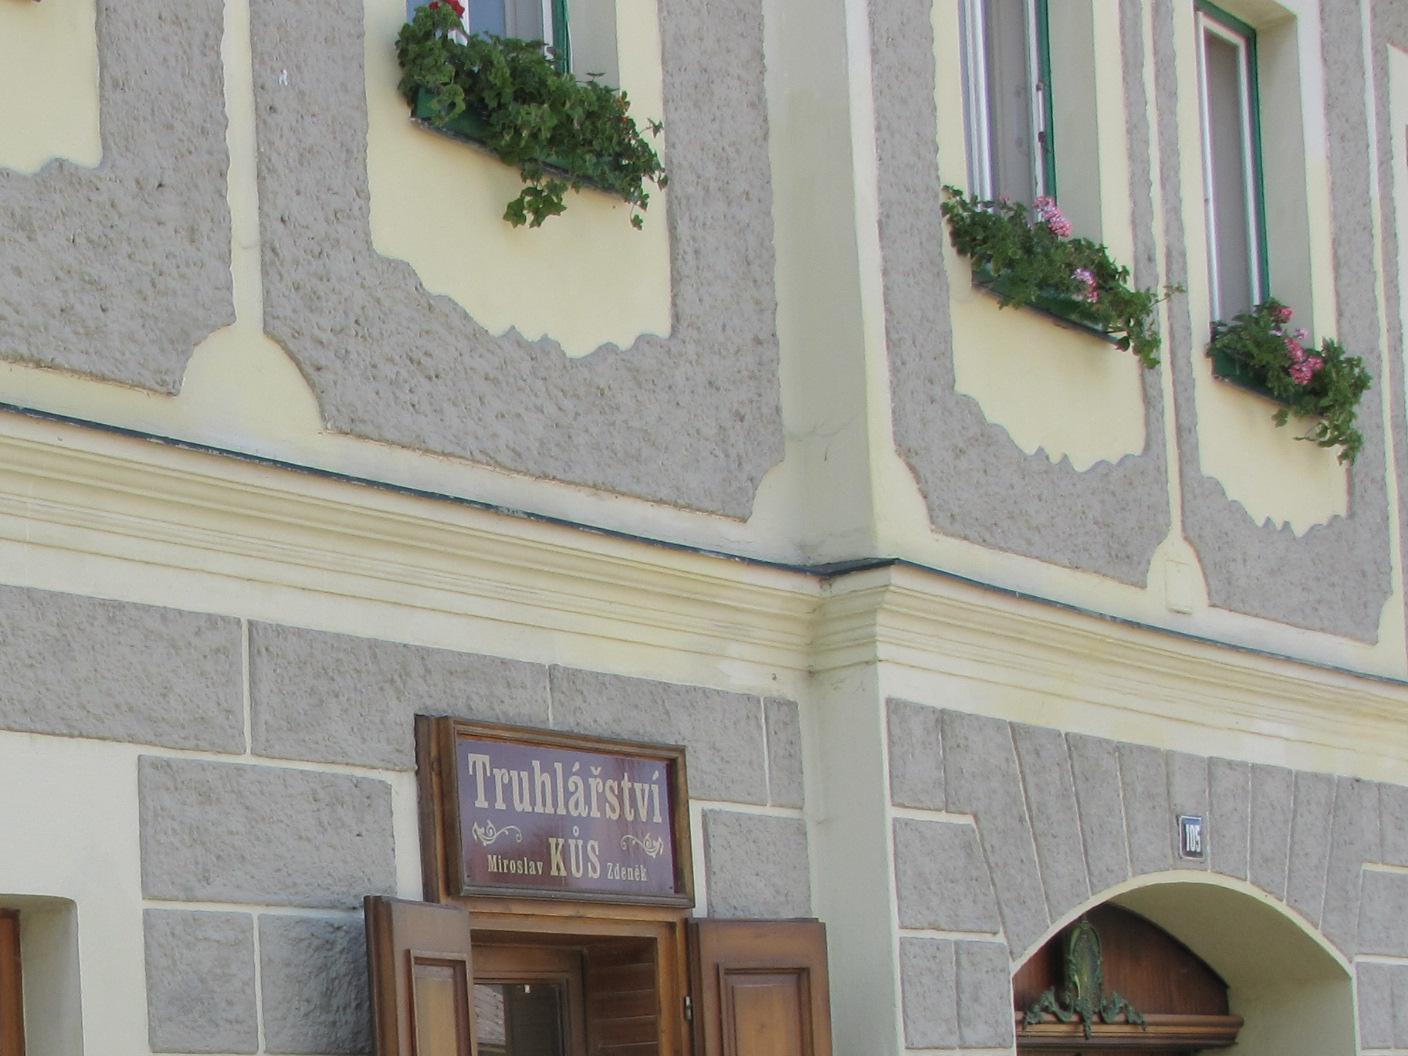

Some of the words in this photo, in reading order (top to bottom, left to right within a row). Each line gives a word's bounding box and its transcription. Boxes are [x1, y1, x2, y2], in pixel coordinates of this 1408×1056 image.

[467, 752, 663, 824] Truhlářství
[487, 854, 544, 876] Miroslav
[548, 825, 601, 879] KŮS
[607, 862, 649, 882] Zdeněk
